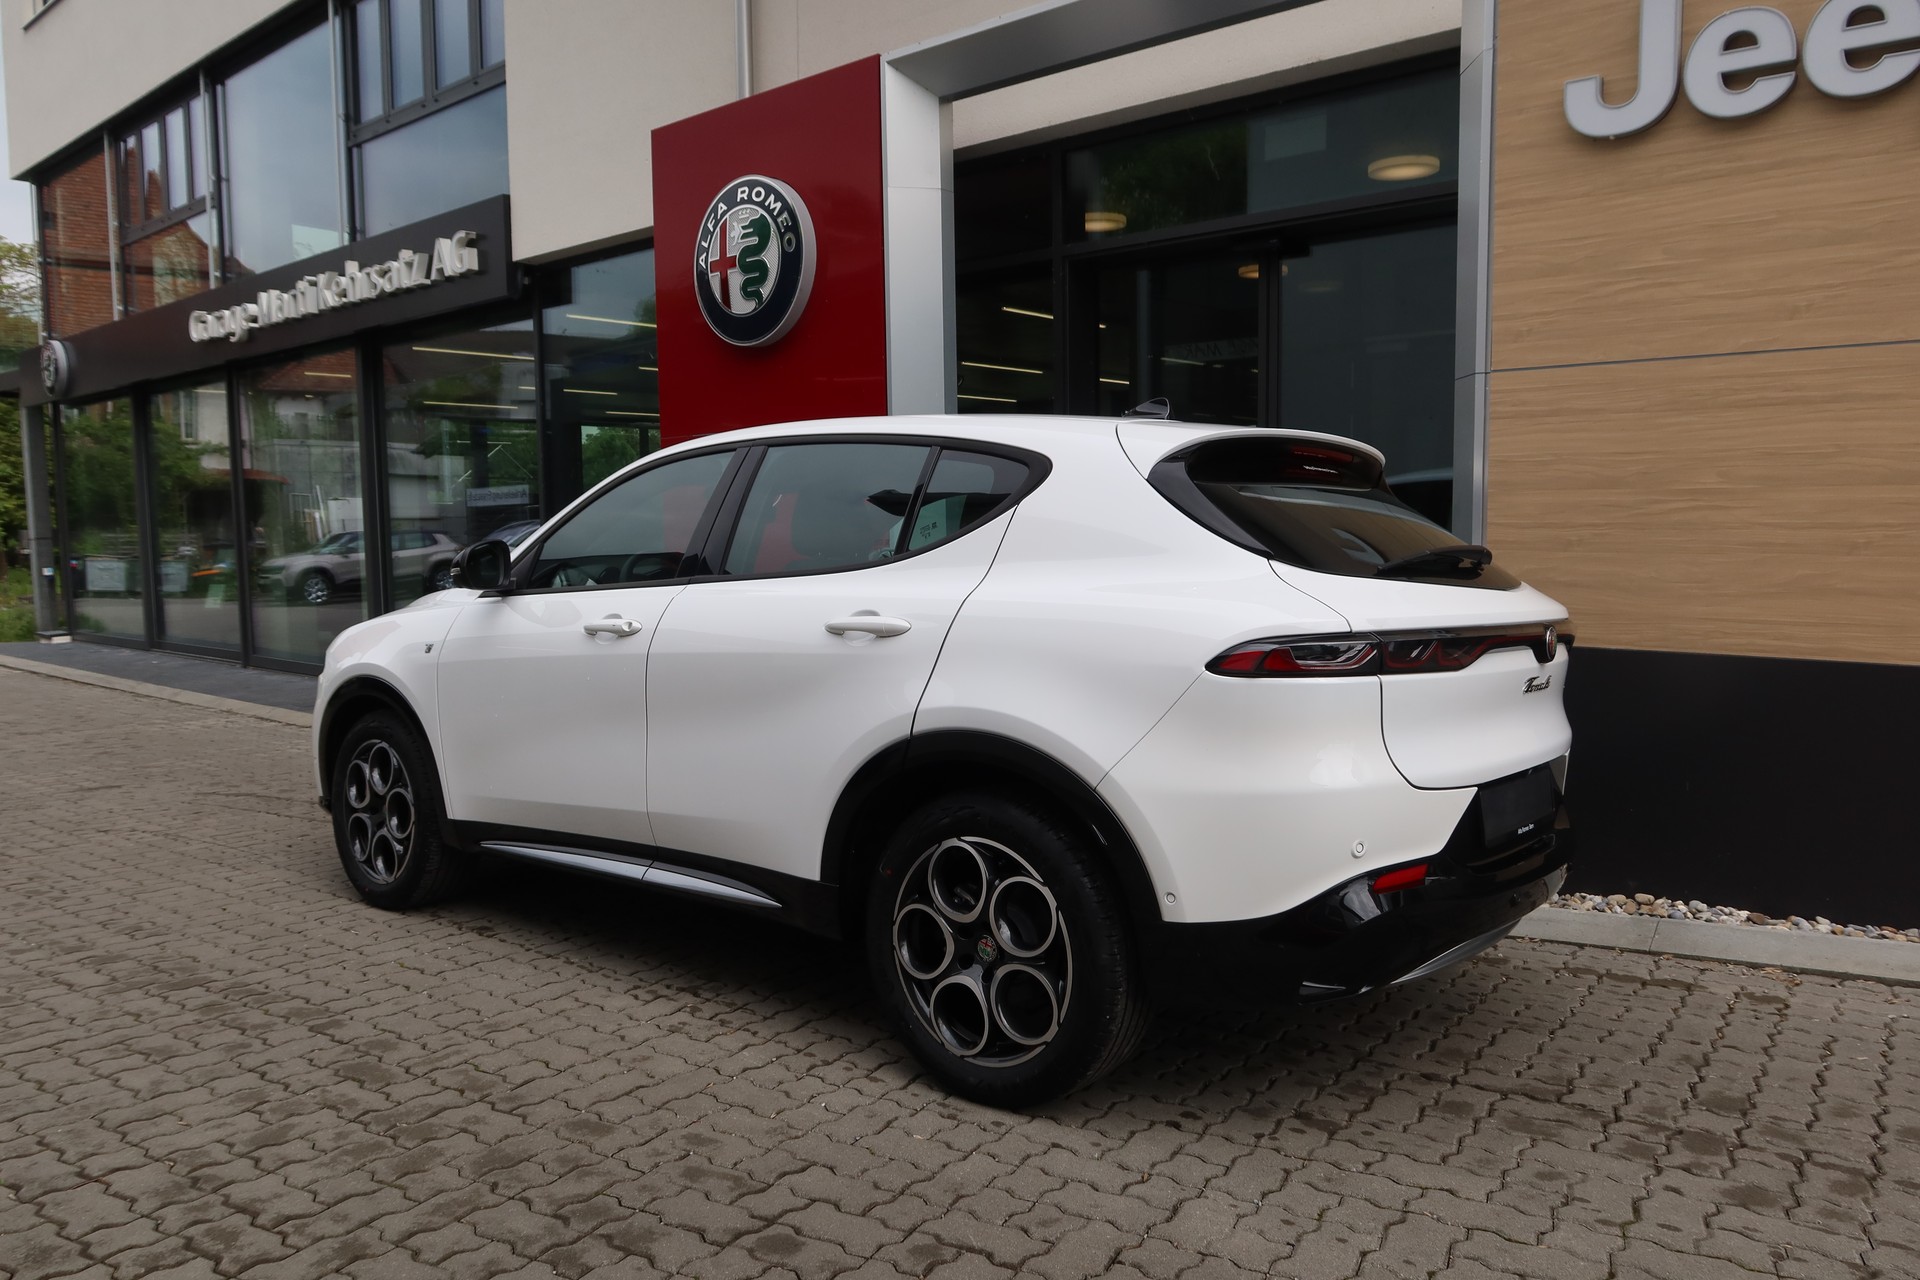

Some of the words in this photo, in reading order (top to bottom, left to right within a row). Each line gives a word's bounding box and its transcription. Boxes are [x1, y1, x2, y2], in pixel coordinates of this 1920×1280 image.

[697, 201, 728, 270] ALFA
[736, 186, 797, 253] ROMEO
[189, 303, 259, 342] Garage
[316, 249, 431, 310] Kehrsatz
[430, 229, 479, 281] AG
